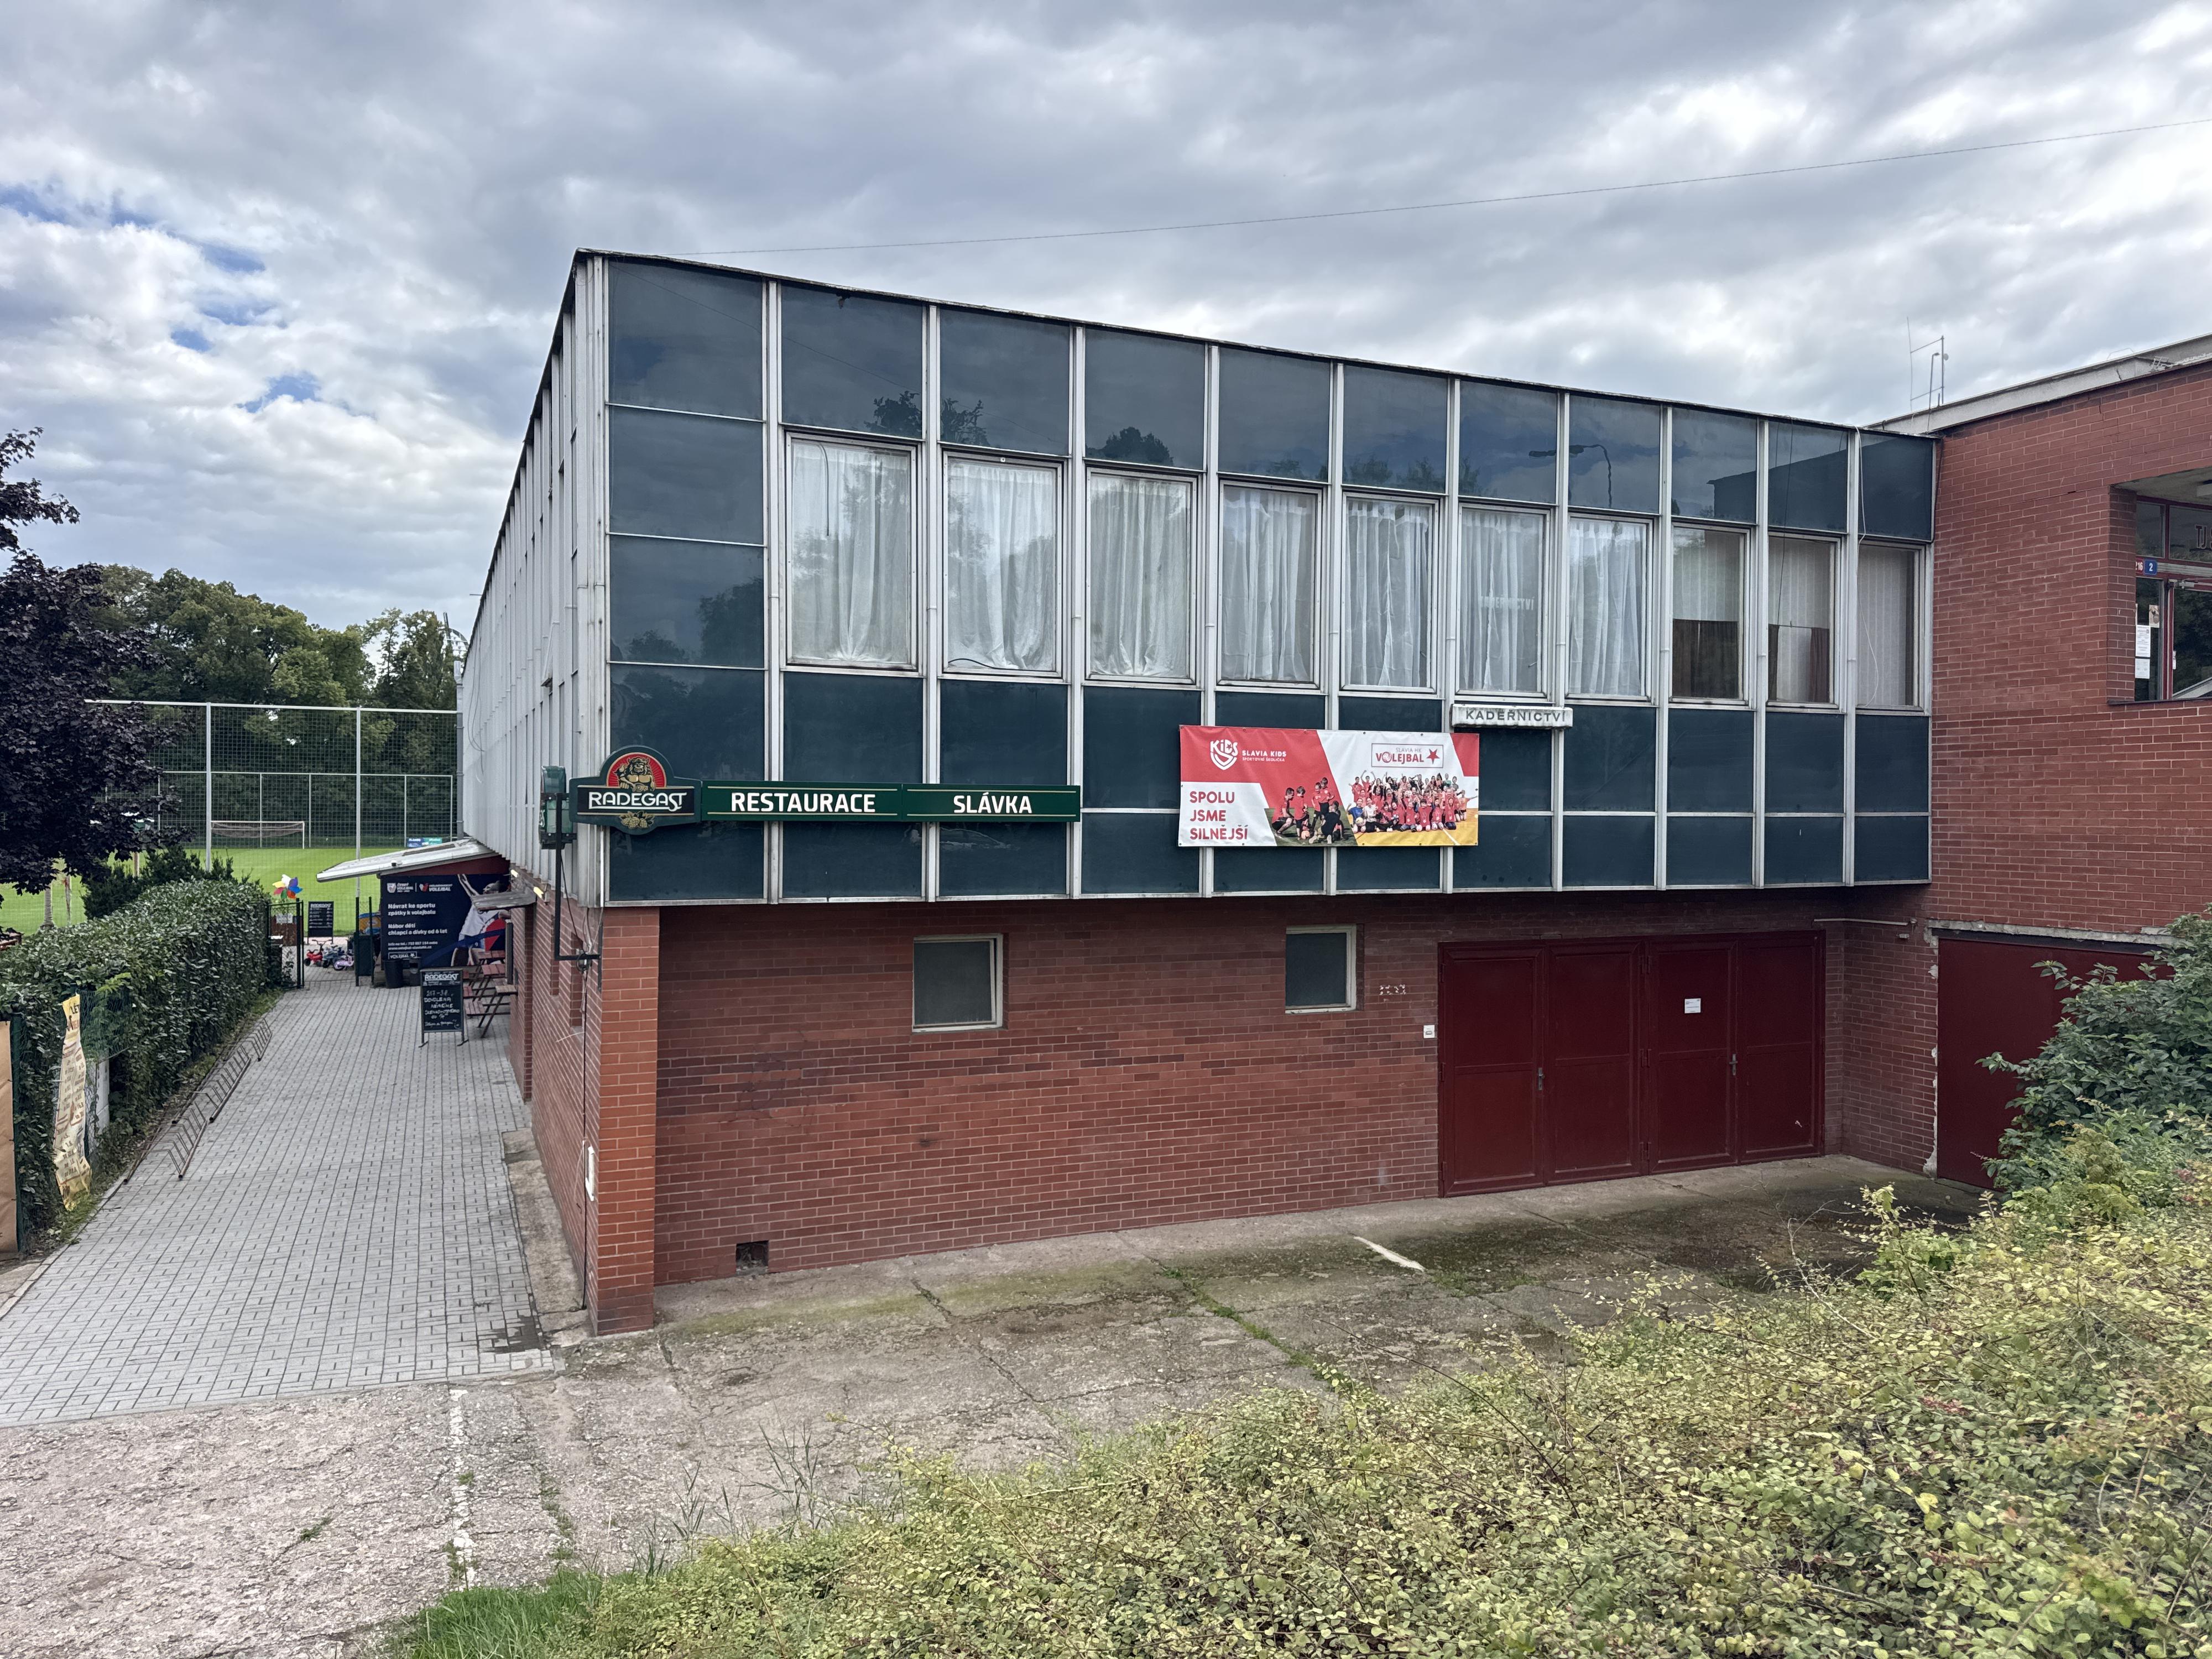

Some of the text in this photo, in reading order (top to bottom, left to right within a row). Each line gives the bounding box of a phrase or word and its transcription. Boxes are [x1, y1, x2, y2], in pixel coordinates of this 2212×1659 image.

[2195, 524, 2207, 549] TJ
[2149, 563, 2153, 572] 2
[1466, 709, 1565, 722] KADEŘNICTVÍ
[1375, 752, 1425, 764] VOLEJBAL
[588, 792, 687, 812] RADEGAST
[731, 792, 1032, 813] RESTAURACE SLÁVKA
[1190, 791, 1235, 804] SPOLU
[1190, 810, 1226, 822] JSME
[1190, 825, 1249, 840] SILNĚJŠÍ
